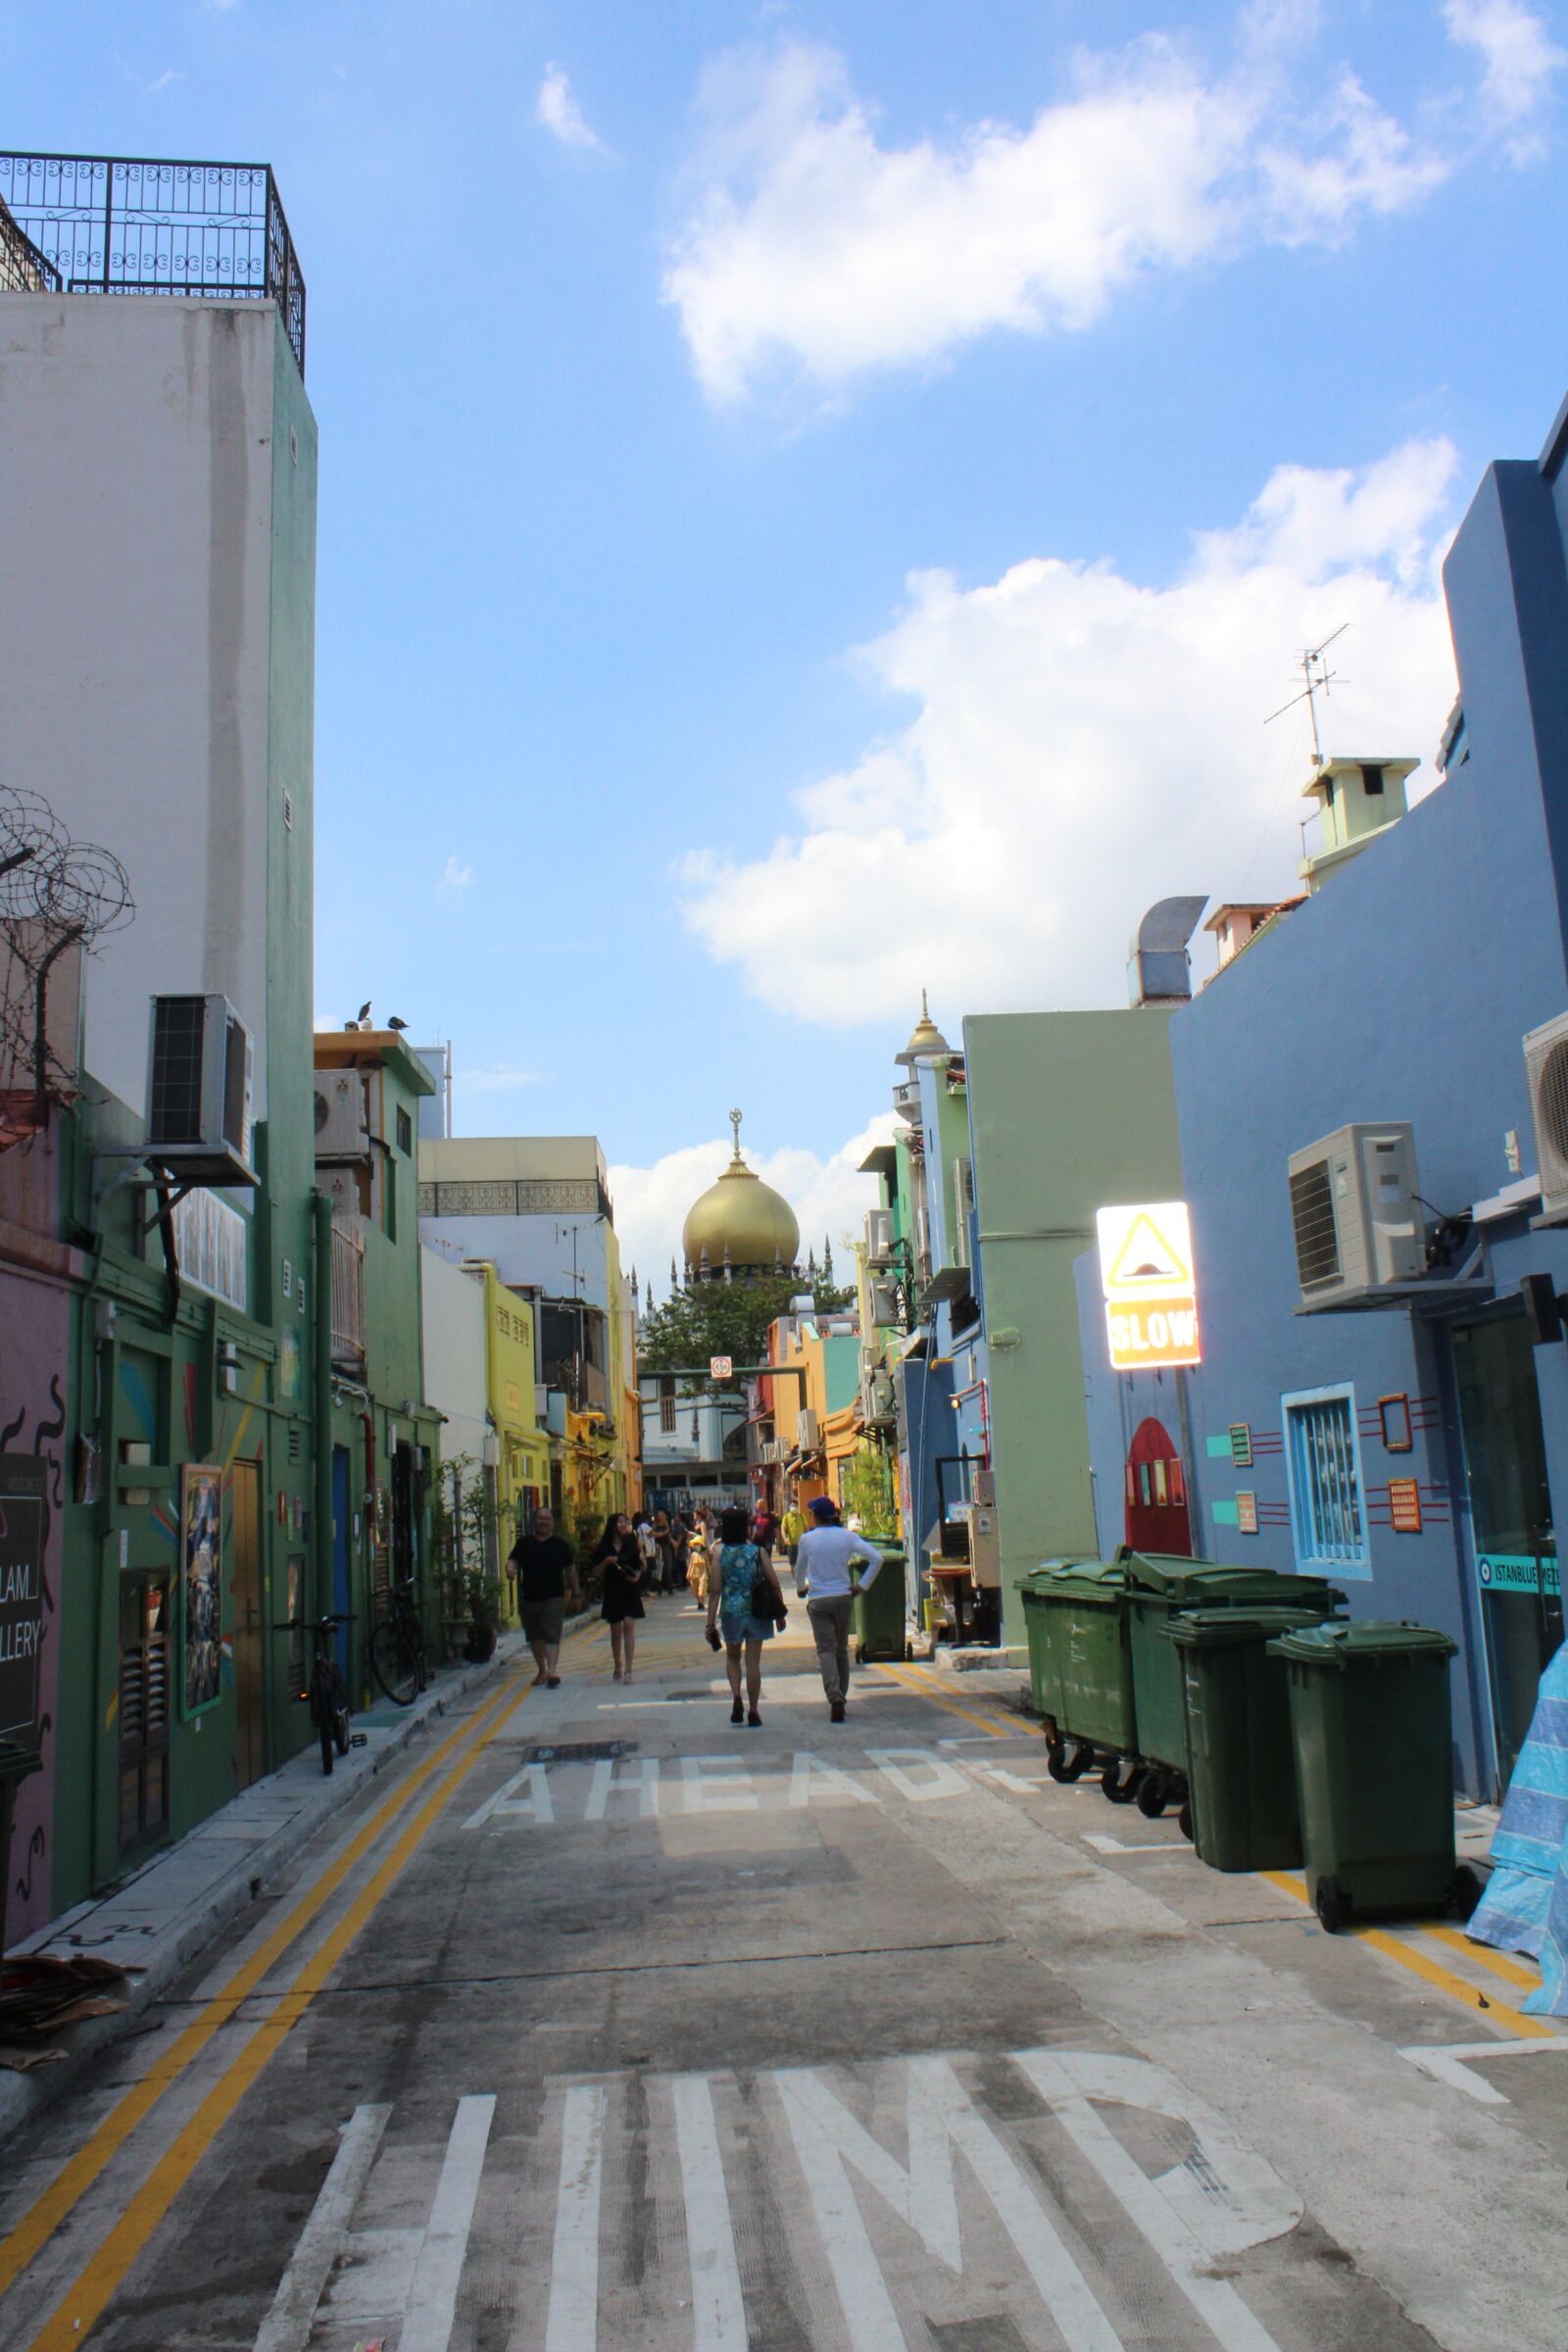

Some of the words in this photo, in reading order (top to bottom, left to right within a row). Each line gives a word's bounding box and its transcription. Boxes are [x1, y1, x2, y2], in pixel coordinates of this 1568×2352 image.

[1111, 1310, 1195, 1350] SLOW
[1494, 1564, 1537, 1584] ISTANBLUE
[462, 1748, 972, 1829] AHEAD
